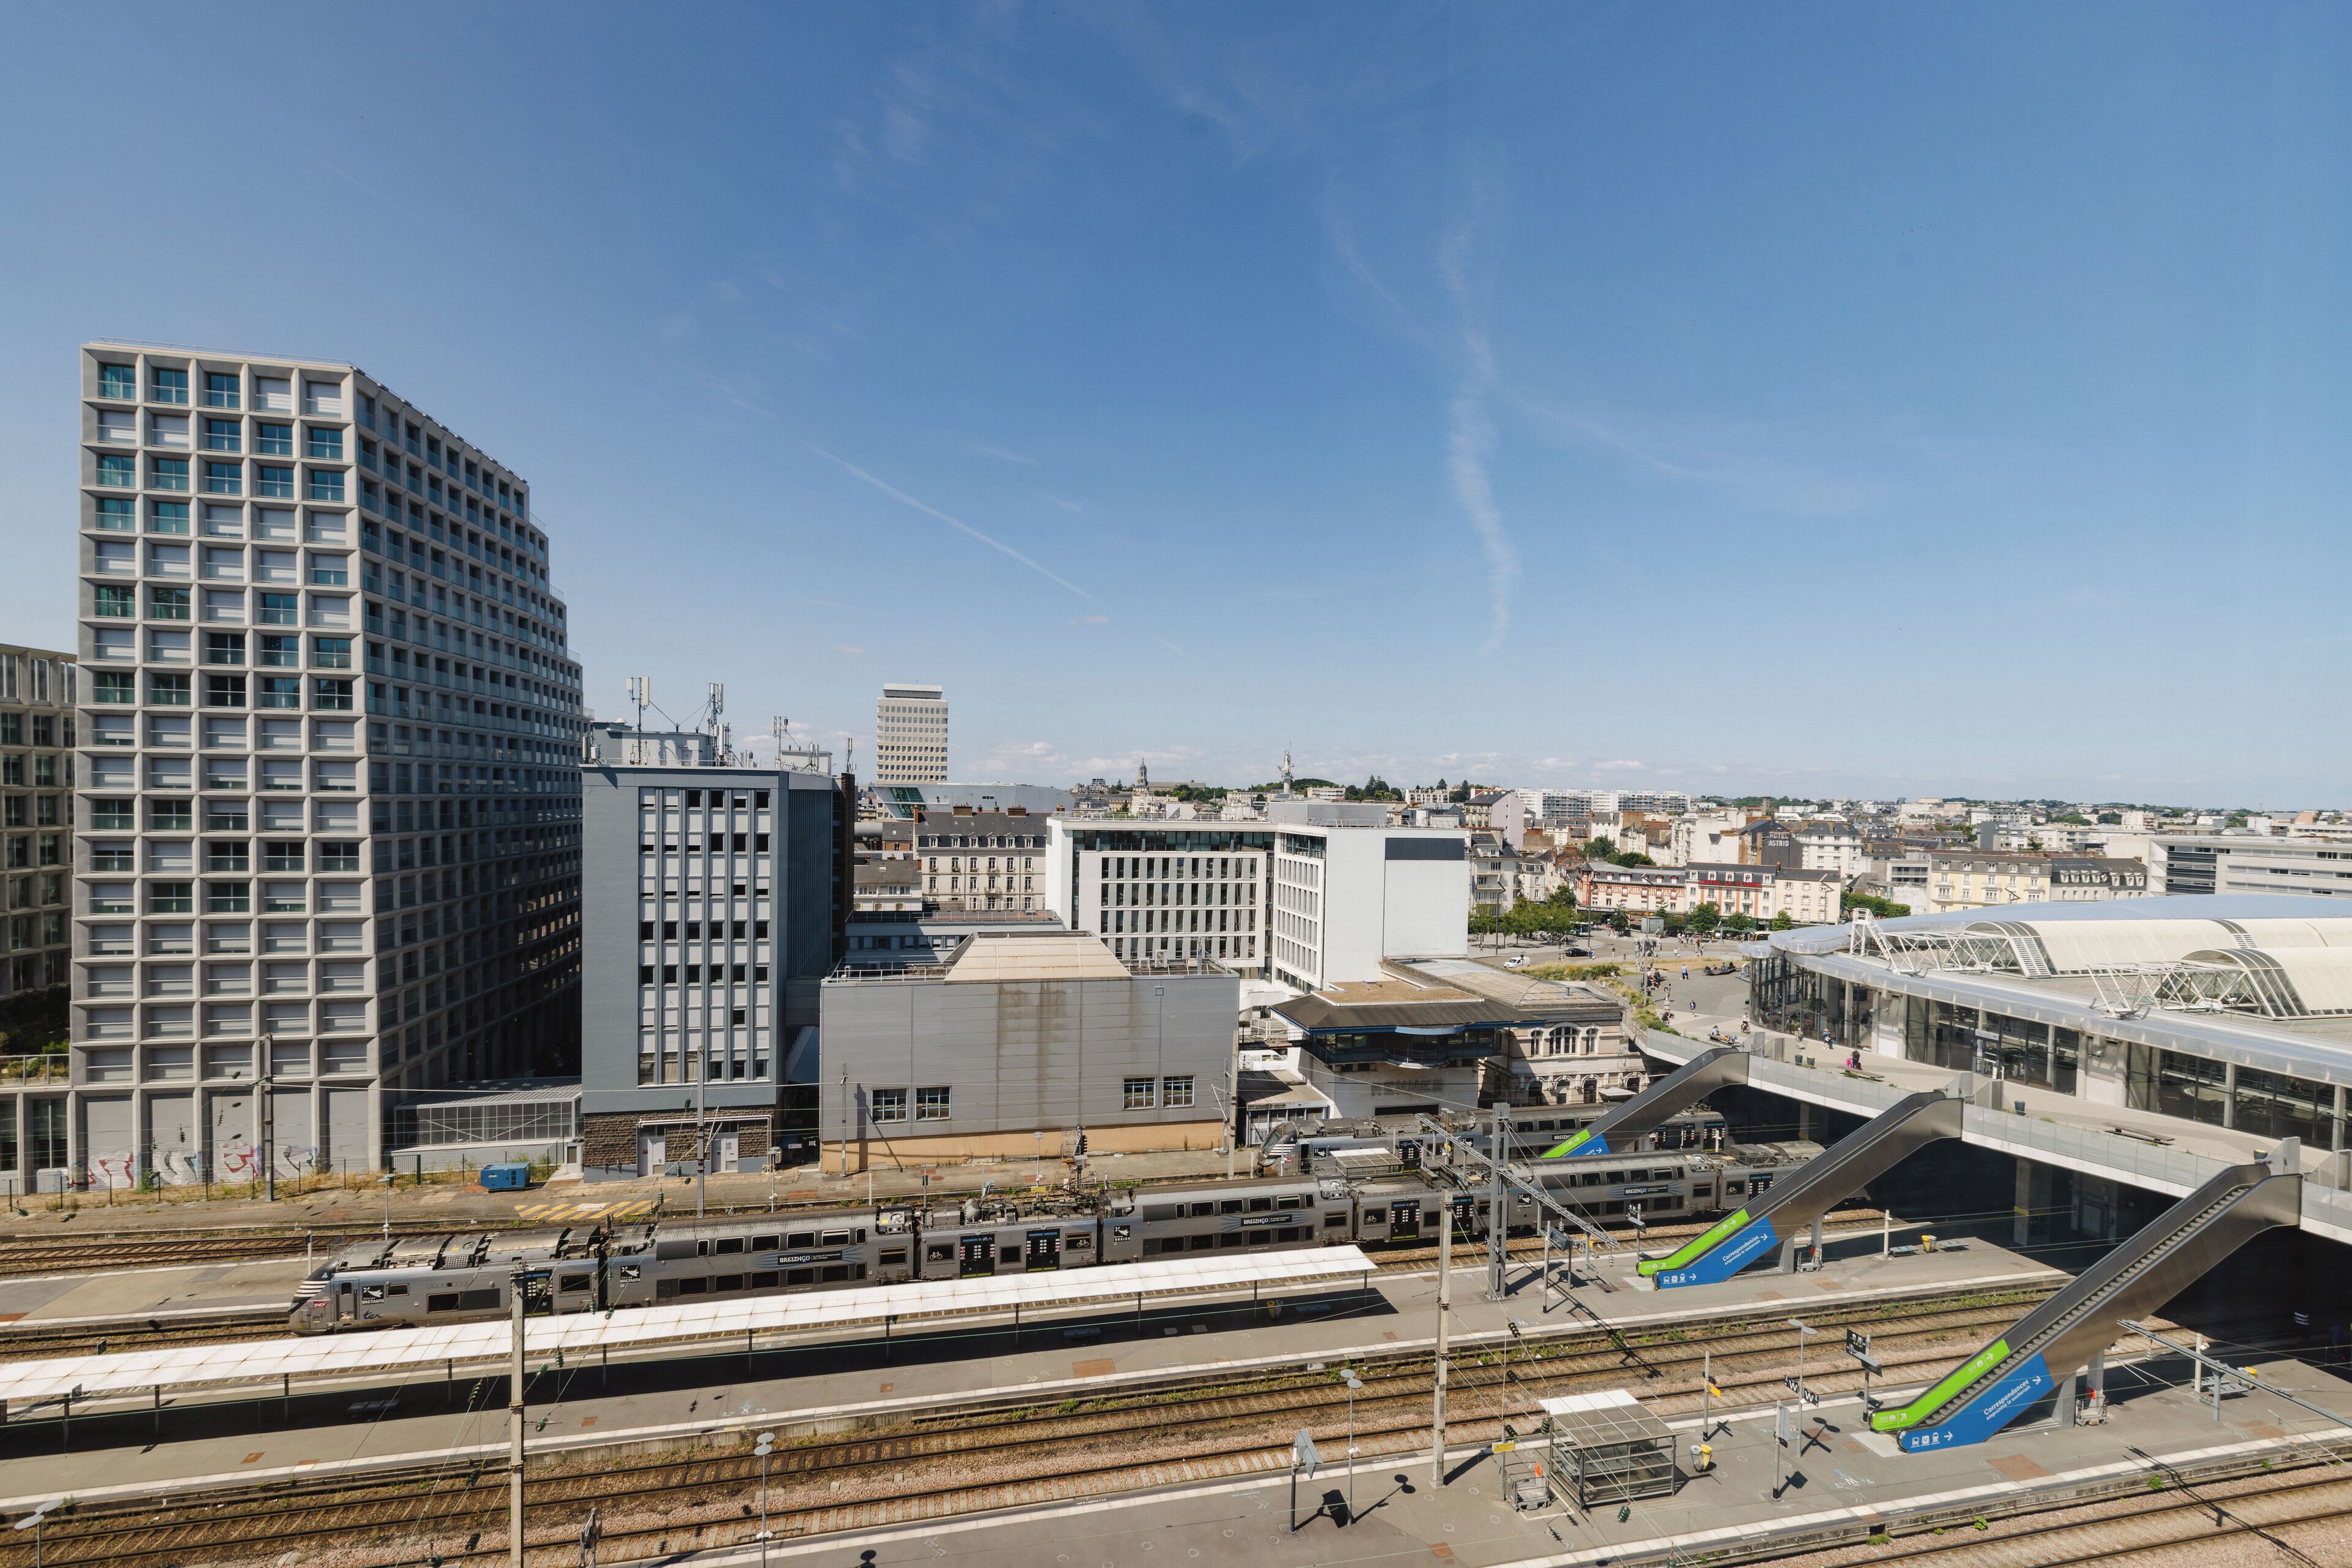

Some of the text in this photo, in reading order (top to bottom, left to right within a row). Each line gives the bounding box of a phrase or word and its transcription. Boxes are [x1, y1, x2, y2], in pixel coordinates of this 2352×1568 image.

[1722, 1235, 1759, 1261] Correspondances
[363, 1310, 383, 1319] ter
[1789, 1379, 1798, 1392] W
[1804, 1390, 1814, 1402] W
[1984, 1379, 2029, 1415] Correspondances
[1986, 1403, 2008, 1420] empruntez
[2011, 1385, 2031, 1401] souterrain
